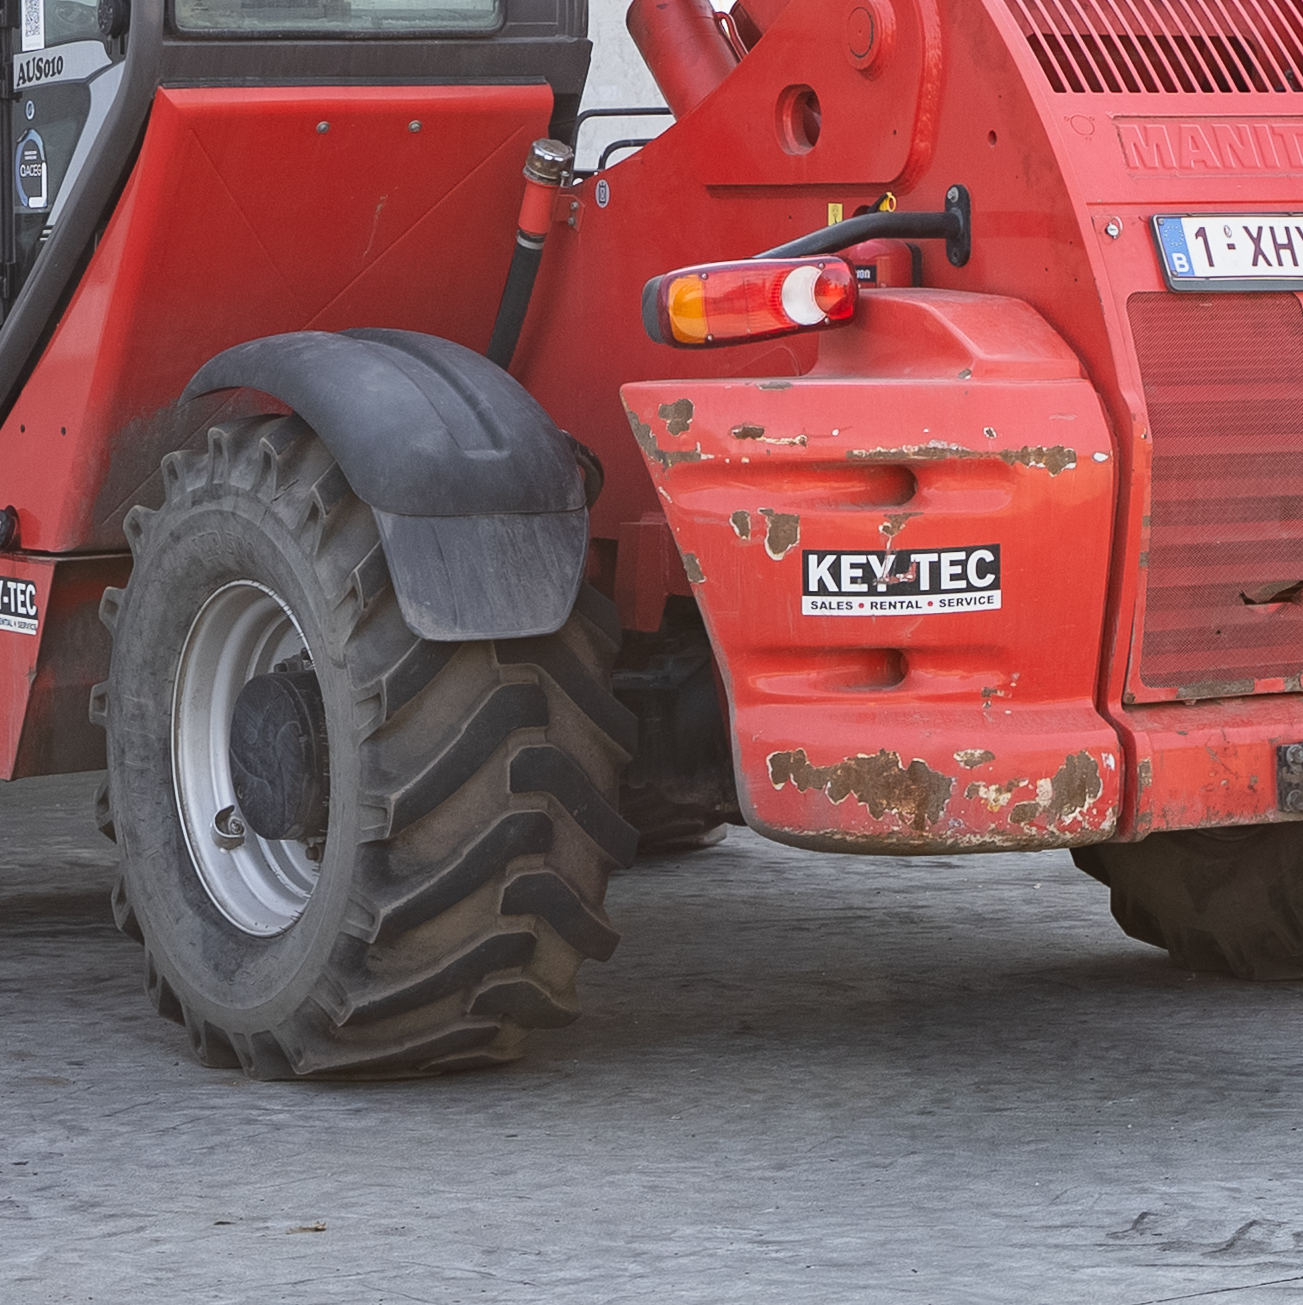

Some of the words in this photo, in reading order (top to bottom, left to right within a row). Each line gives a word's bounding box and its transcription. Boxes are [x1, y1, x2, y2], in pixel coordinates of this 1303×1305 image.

[16, 55, 64, 88] AUS010
[1170, 252, 1190, 273] B
[808, 549, 996, 592] KEY-TEC
[810, 601, 854, 611] SALES
[870, 600, 923, 611] RENTAL
[939, 595, 995, 608] SERVICE
